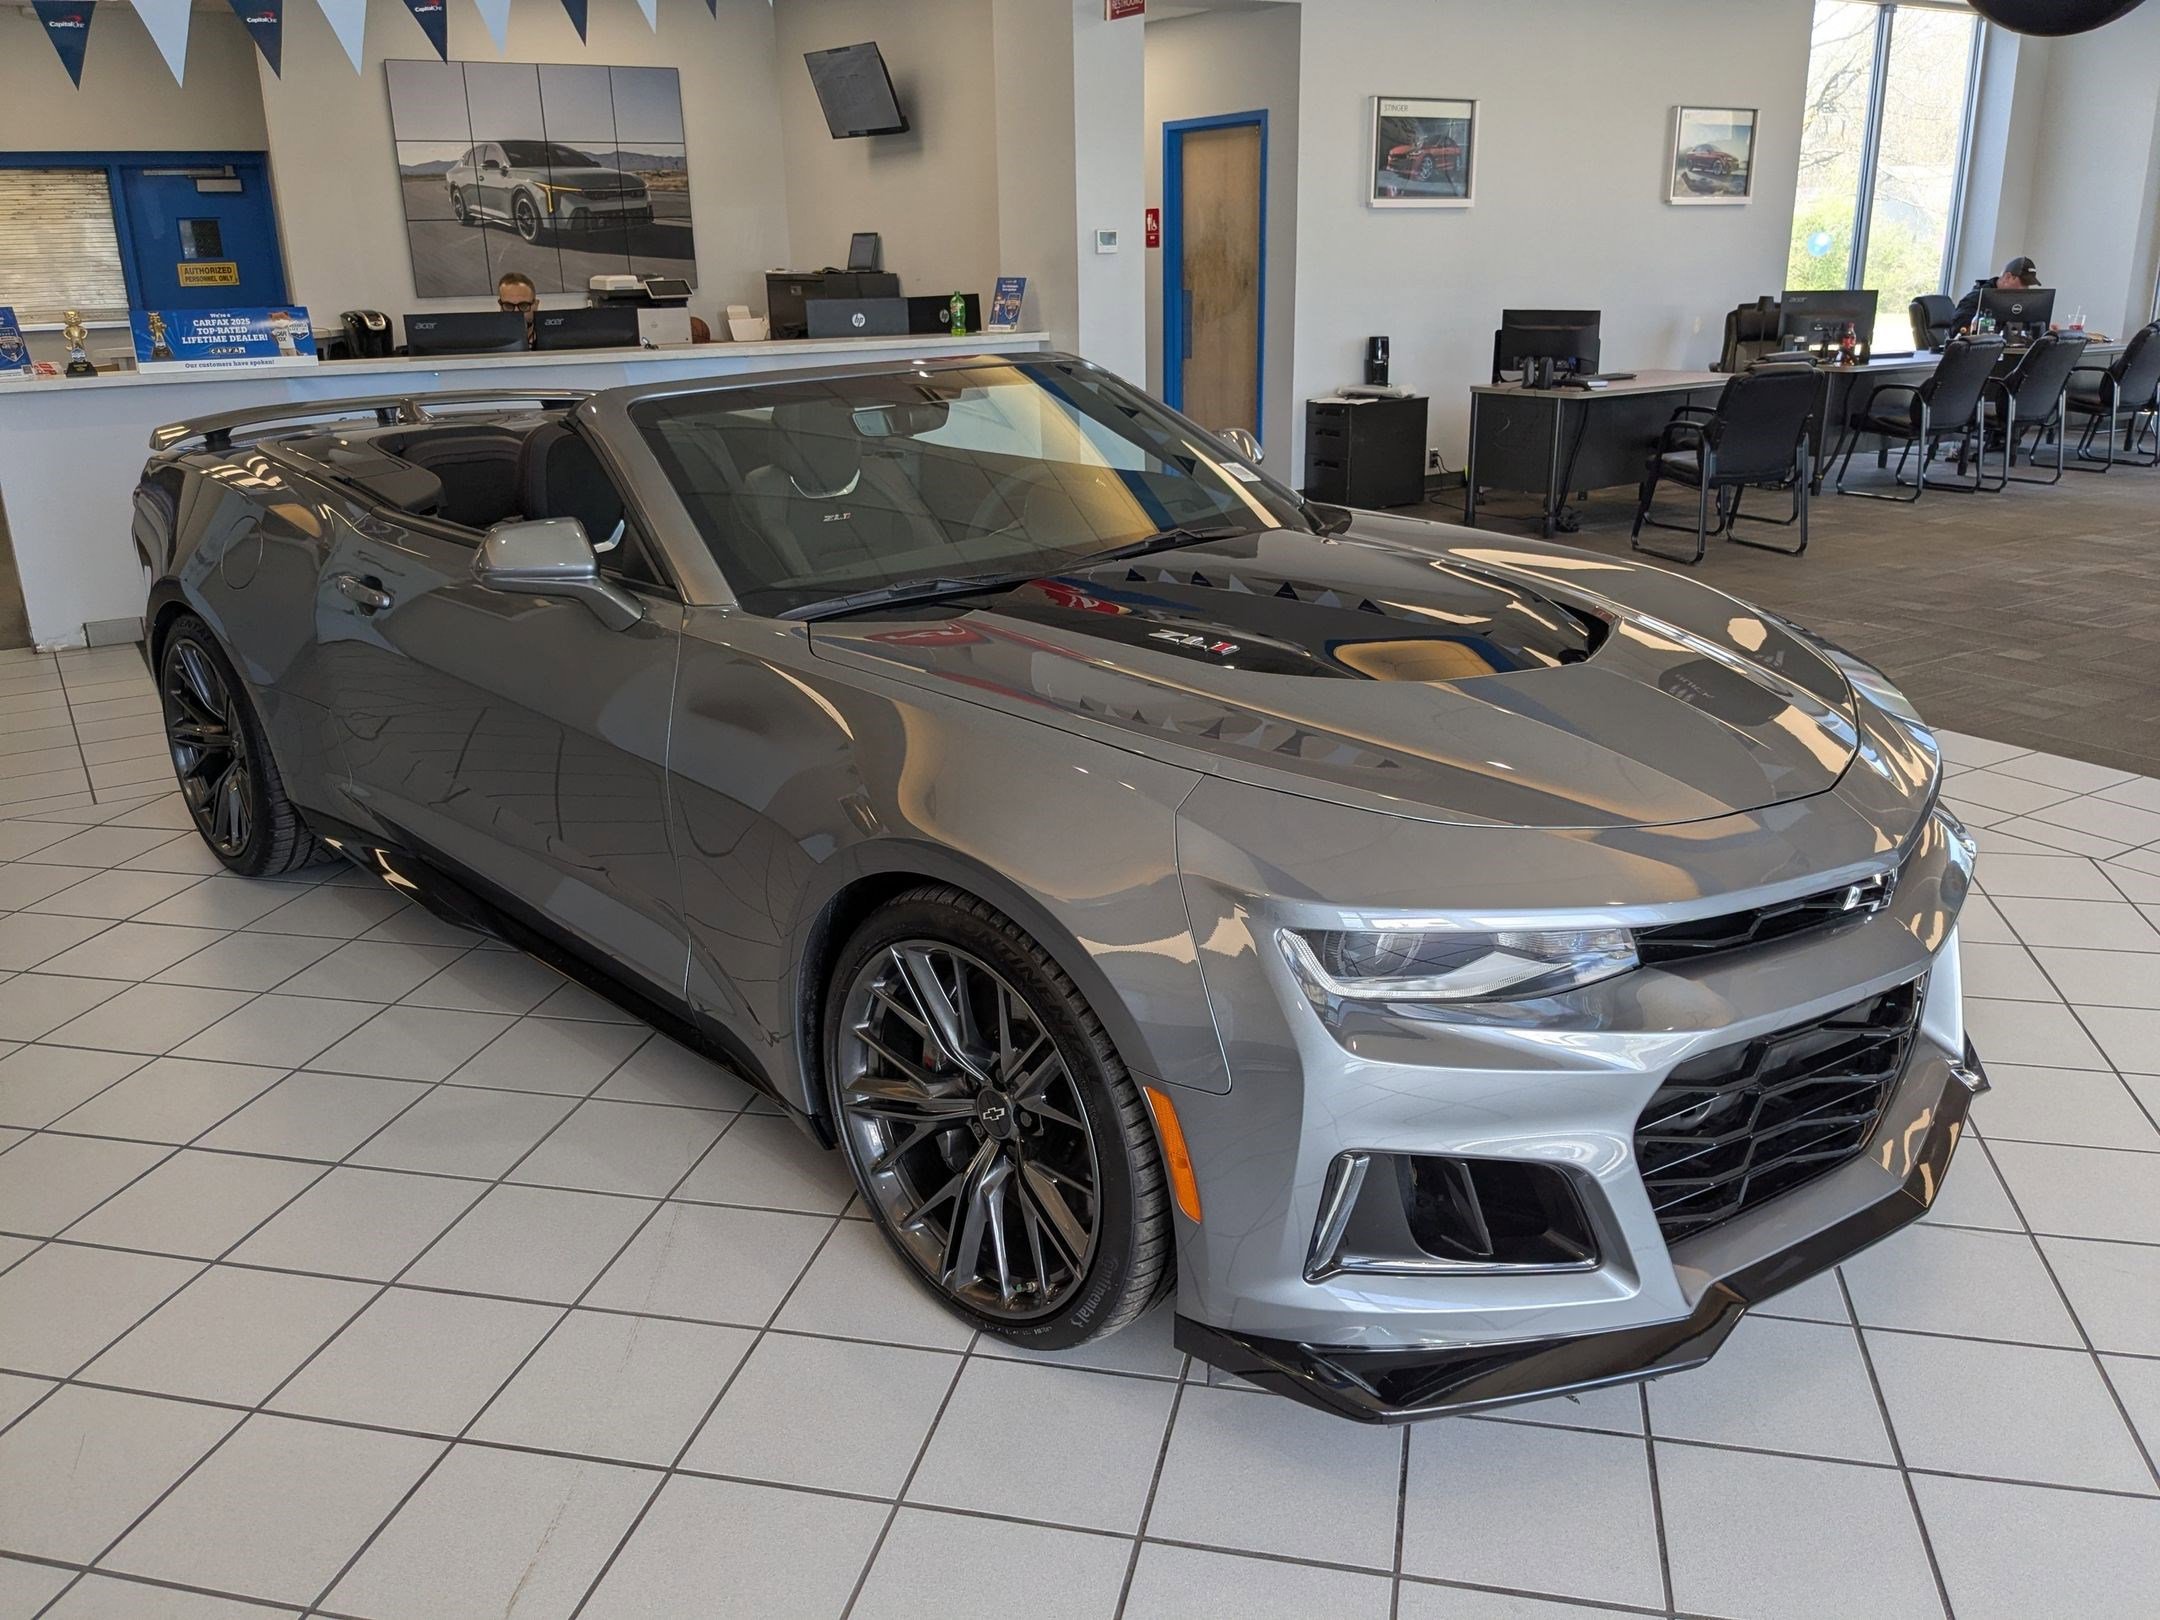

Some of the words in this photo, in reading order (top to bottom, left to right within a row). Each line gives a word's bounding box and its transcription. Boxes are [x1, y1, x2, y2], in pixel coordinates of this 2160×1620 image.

[184, 267, 232, 275] AUTHORIZED
[193, 319, 229, 327] CARFAX
[852, 313, 866, 327] hp
[414, 322, 437, 330] acer
[197, 326, 248, 335] TOP-RATED
[182, 335, 227, 344] LIFETIME
[229, 334, 268, 343] DEALER!
